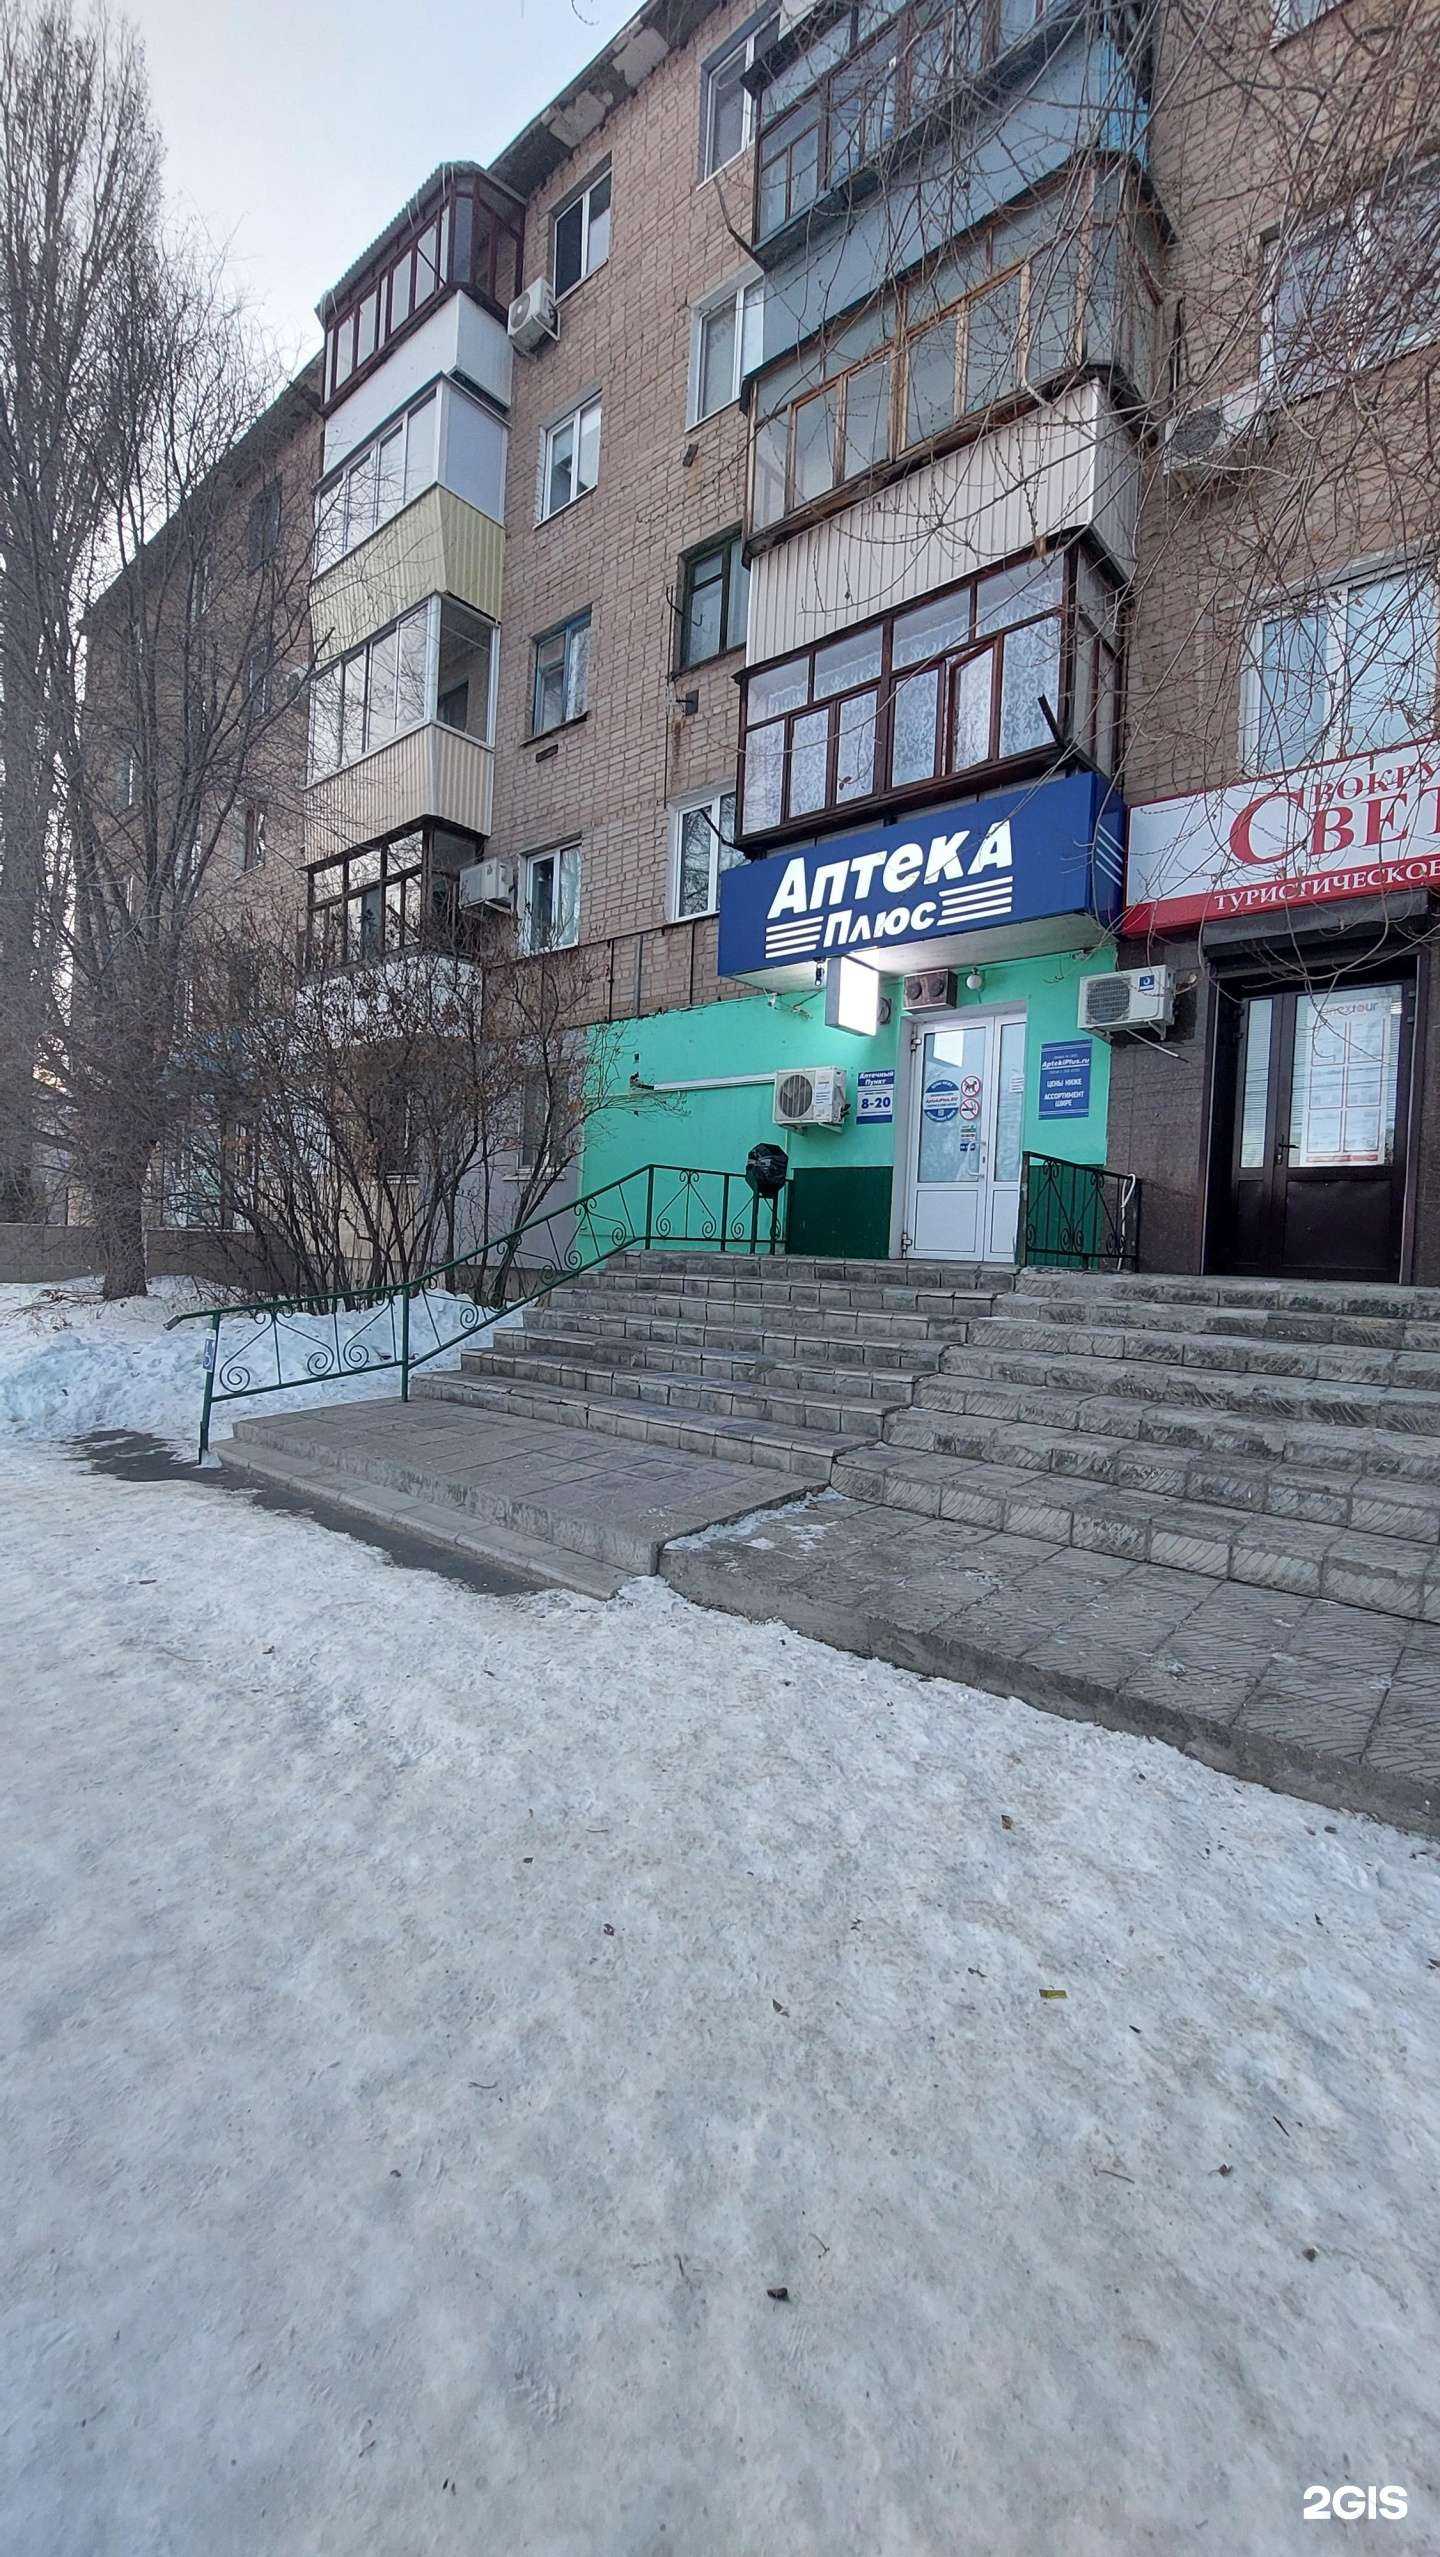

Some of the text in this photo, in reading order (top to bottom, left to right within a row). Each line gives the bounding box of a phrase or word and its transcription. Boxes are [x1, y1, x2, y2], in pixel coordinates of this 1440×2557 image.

[1215, 859, 1440, 912] ТУРИСТИЧЕСКОЕ
[1044, 1091, 1084, 1100] АССОРТИМЕНТ
[861, 1097, 891, 1109] 8-20
